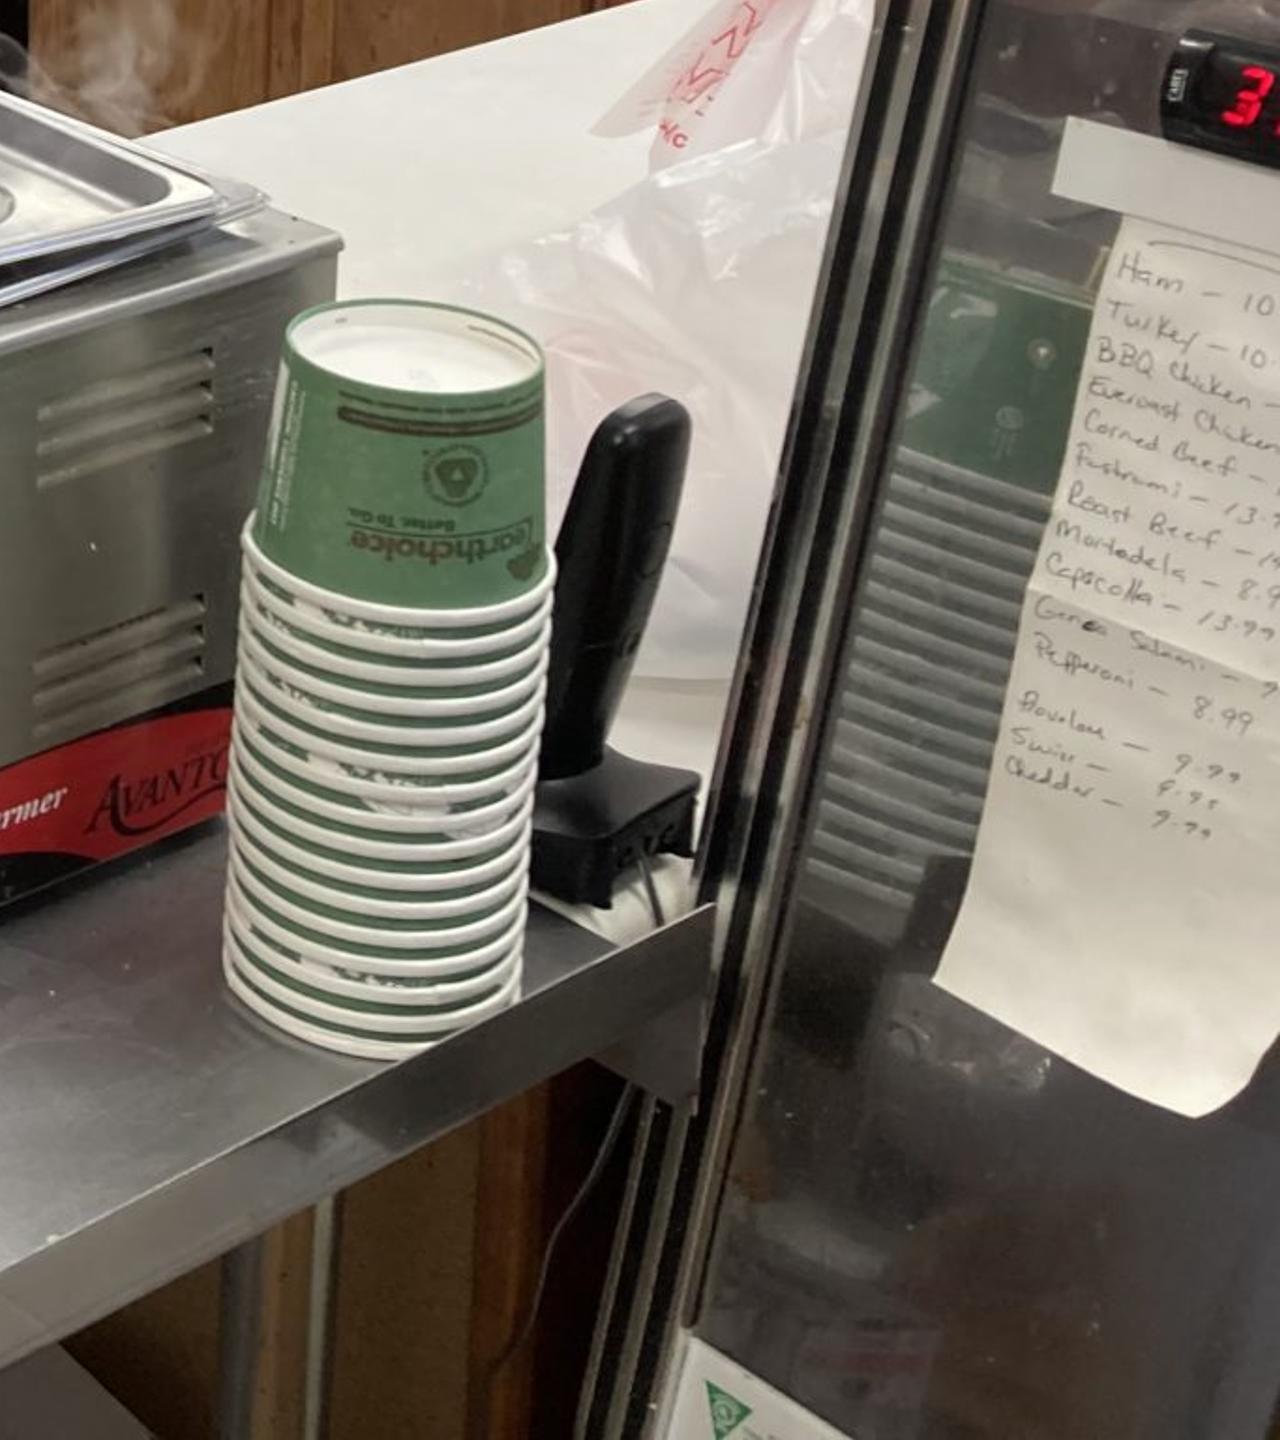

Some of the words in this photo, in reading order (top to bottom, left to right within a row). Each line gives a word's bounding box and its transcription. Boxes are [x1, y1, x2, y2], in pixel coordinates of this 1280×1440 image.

[1117, 251, 1184, 293] Ham
[1106, 297, 1200, 355] Turkey
[1097, 335, 1154, 380] BBQ
[1169, 360, 1252, 410] Chicken
[1084, 407, 1159, 451] Corned
[1172, 441, 1239, 477] Beef
[1068, 479, 1131, 523] Roast
[1149, 511, 1222, 550] Beef
[350, 527, 529, 565] earthchoice
[1193, 695, 1254, 737] 8.99
[1005, 754, 1095, 798] Cheddar
